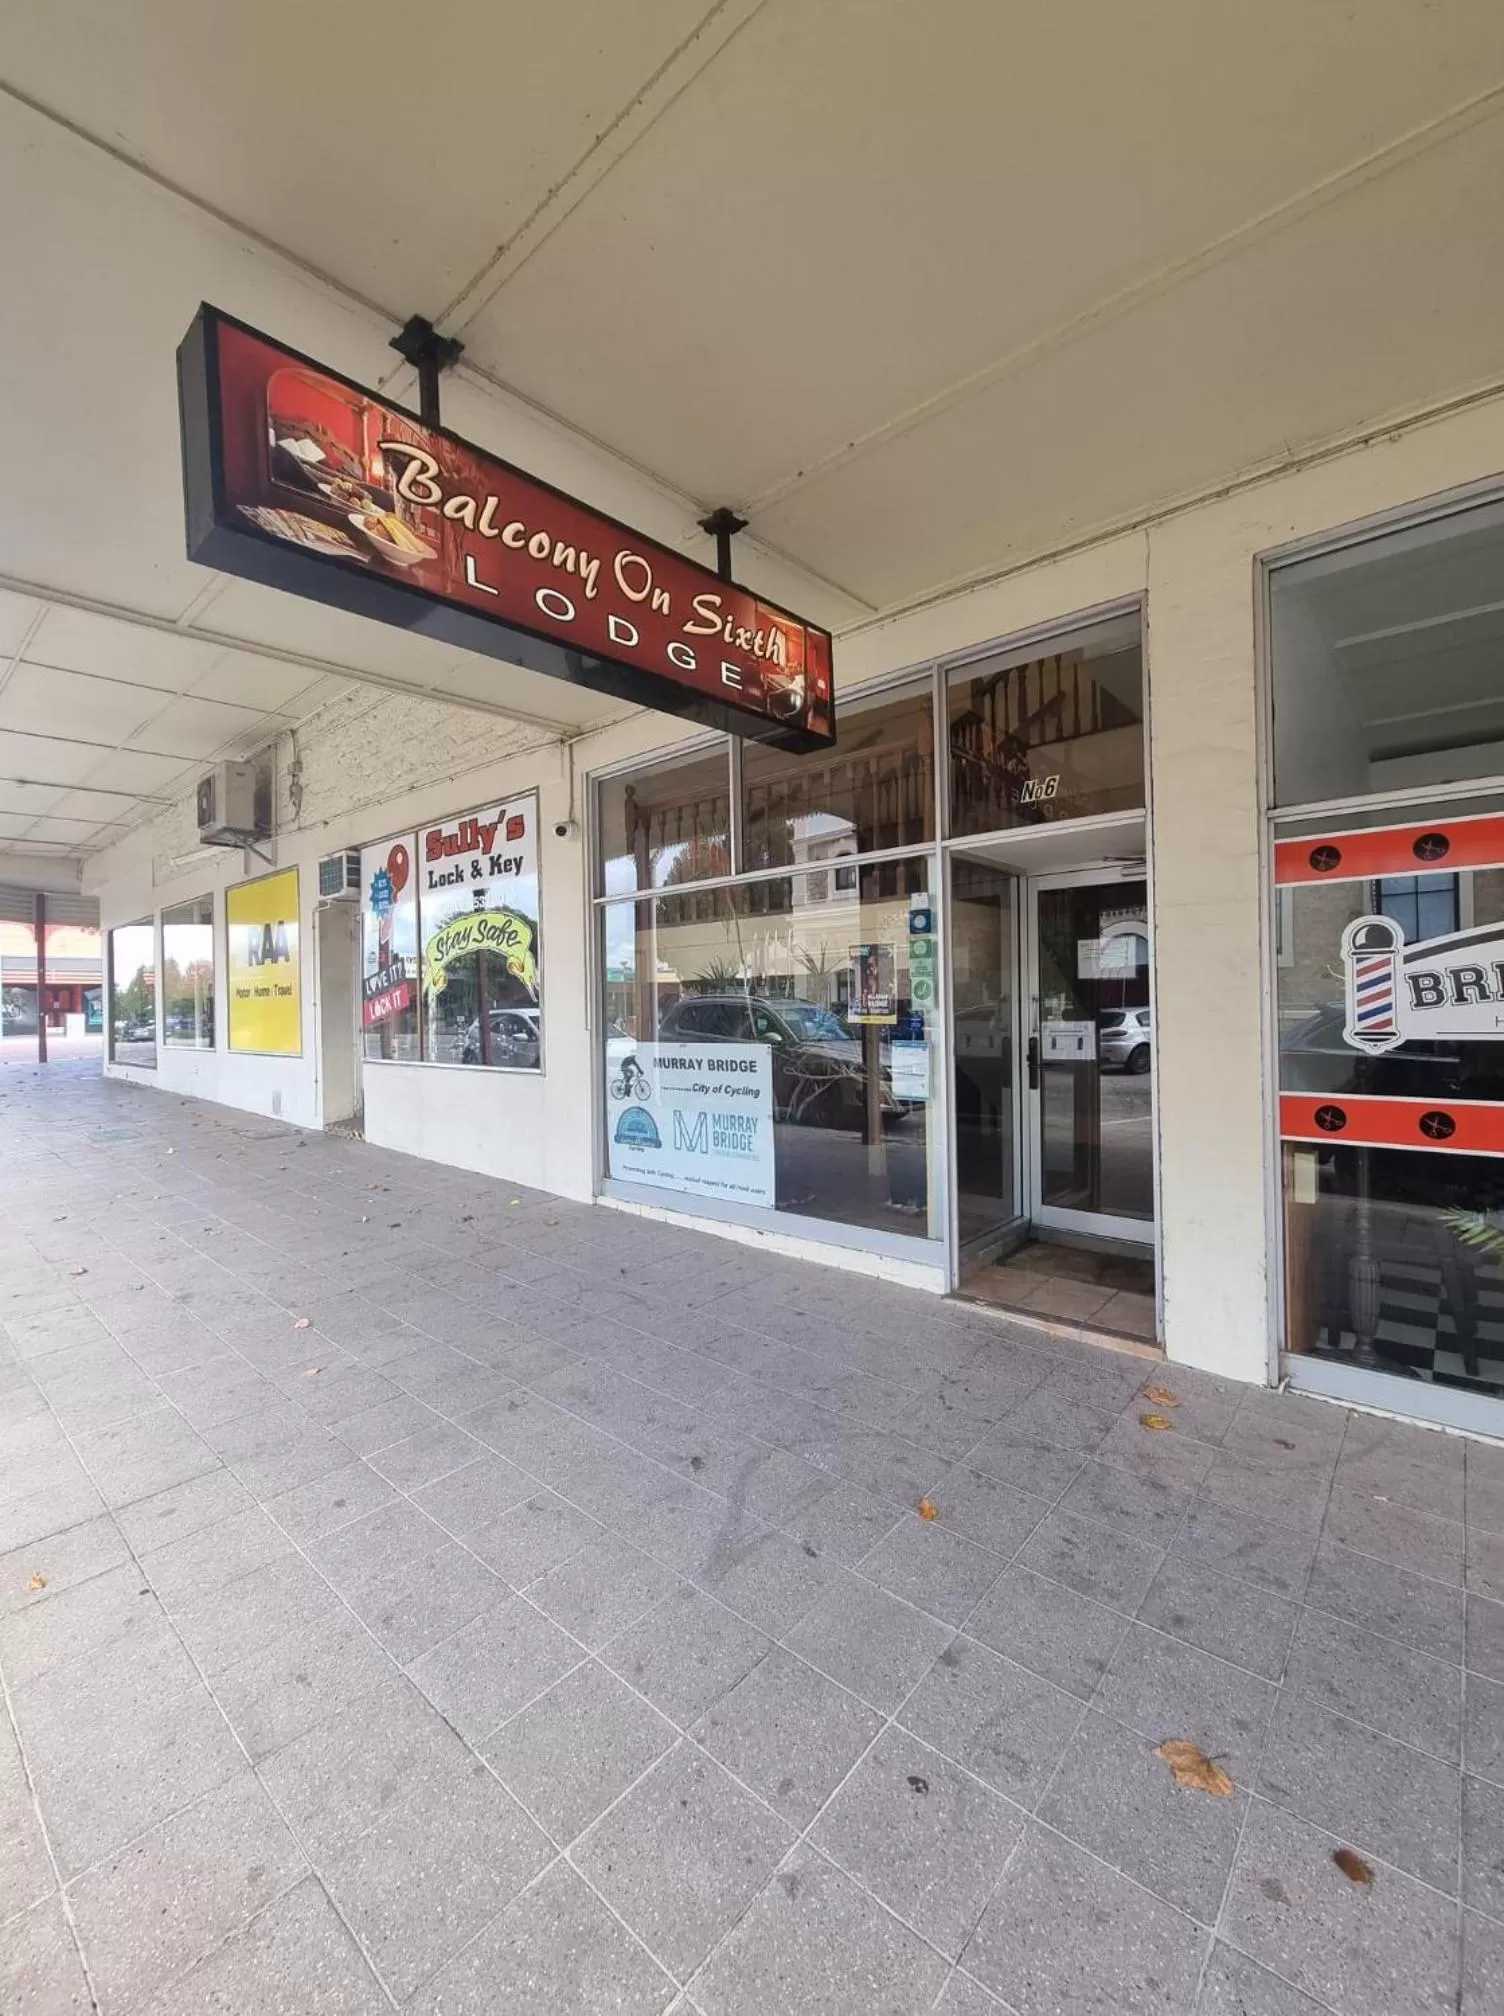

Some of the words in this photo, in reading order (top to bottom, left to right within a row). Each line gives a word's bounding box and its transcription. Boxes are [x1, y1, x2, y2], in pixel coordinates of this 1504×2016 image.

[378, 441, 601, 599] Balcony
[613, 549, 671, 615] On
[683, 594, 787, 666] Sixth
[466, 555, 744, 691] LODGE
[426, 809, 525, 863] Sully's
[428, 864, 464, 890] Lock
[471, 859, 483, 879] &
[489, 853, 524, 878] Key
[247, 920, 290, 967] RAA
[434, 925, 474, 962] Stay
[472, 919, 522, 947] Safe
[389, 962, 403, 983] IT?
[236, 986, 250, 998] Motor
[254, 985, 270, 997] Home
[274, 982, 293, 996] Travel
[369, 994, 392, 1019] LOCK
[393, 990, 401, 1009] IT
[653, 1056, 703, 1071] MURRAY
[708, 1059, 758, 1073] BRIDGE
[712, 1083, 723, 1095] of
[724, 1084, 761, 1099] Cycling
[712, 1113, 759, 1135] MURRAY
[712, 1130, 754, 1152] BRIDGE
